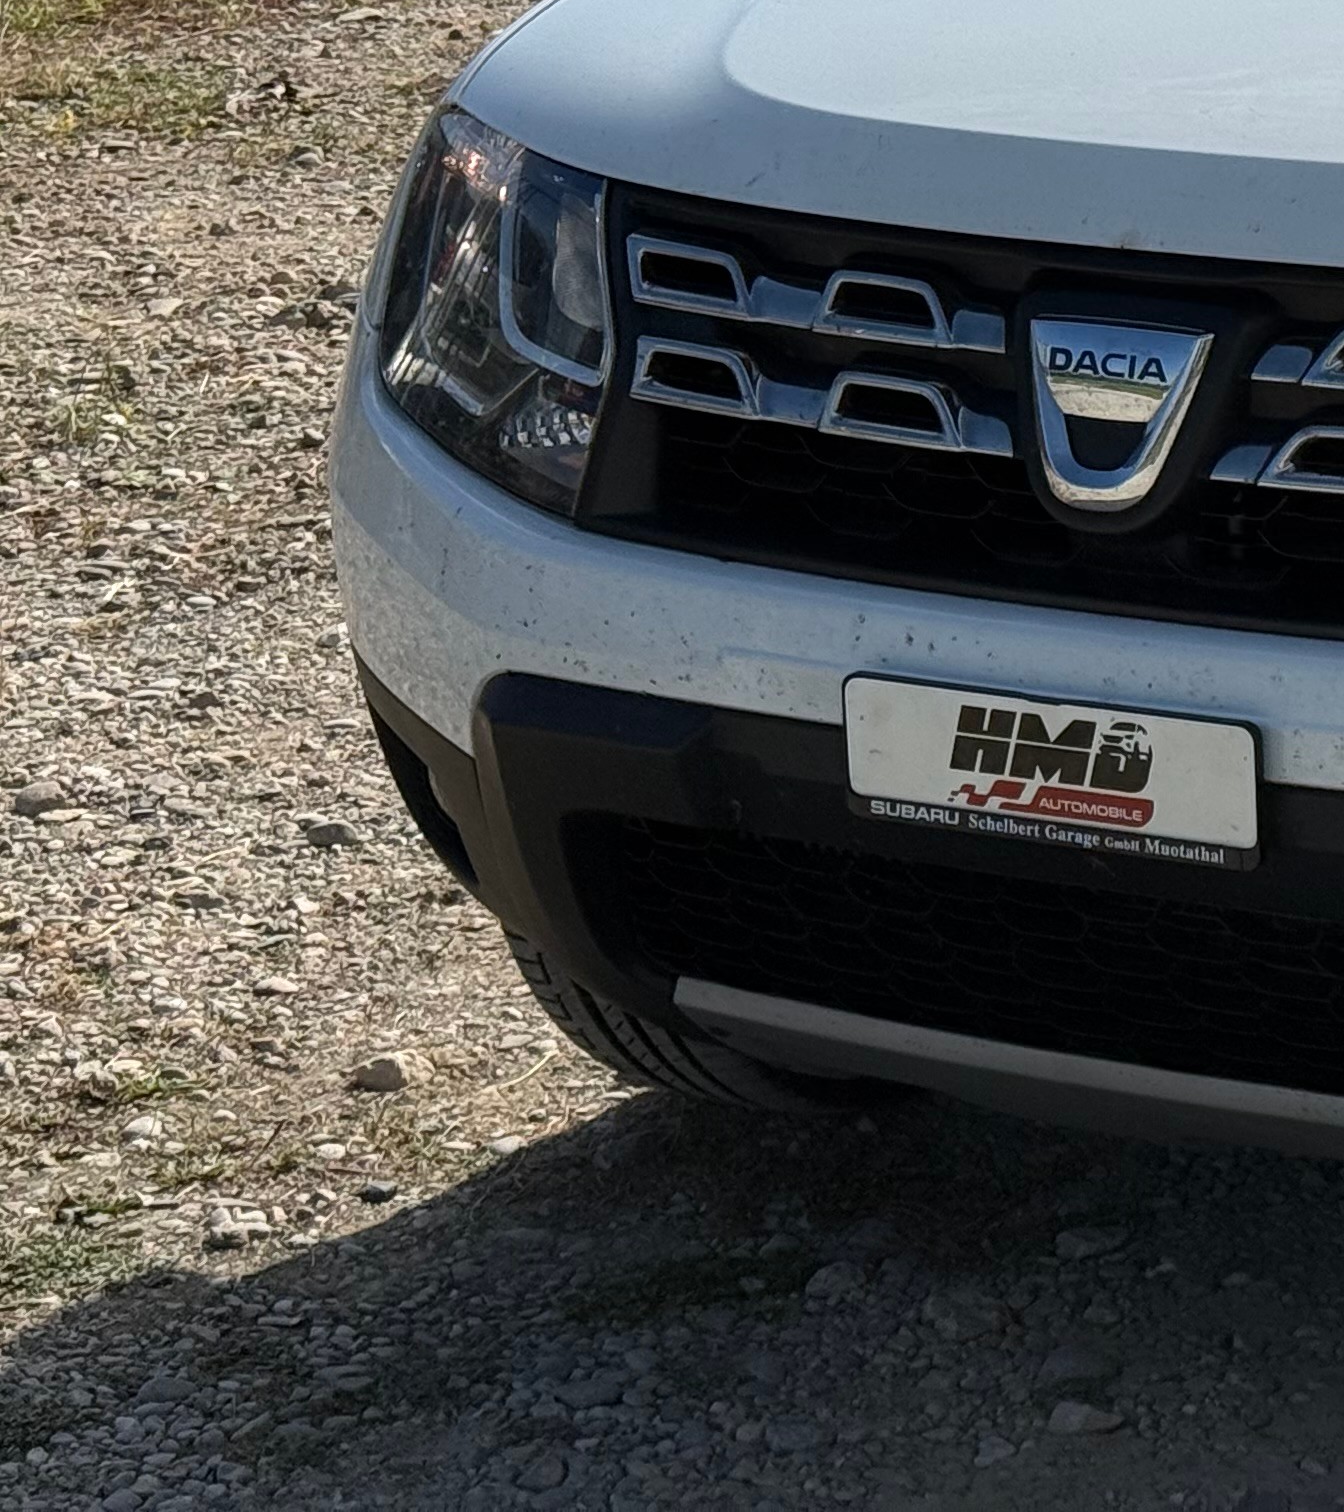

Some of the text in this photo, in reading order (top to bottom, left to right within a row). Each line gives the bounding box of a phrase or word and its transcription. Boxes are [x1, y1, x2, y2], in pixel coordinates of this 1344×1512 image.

[1049, 346, 1168, 383] DACIA
[1038, 797, 1144, 823] AUTOMOBILE
[870, 799, 1226, 865] SUBARU Schelbert Garage GmbH Muotathal
